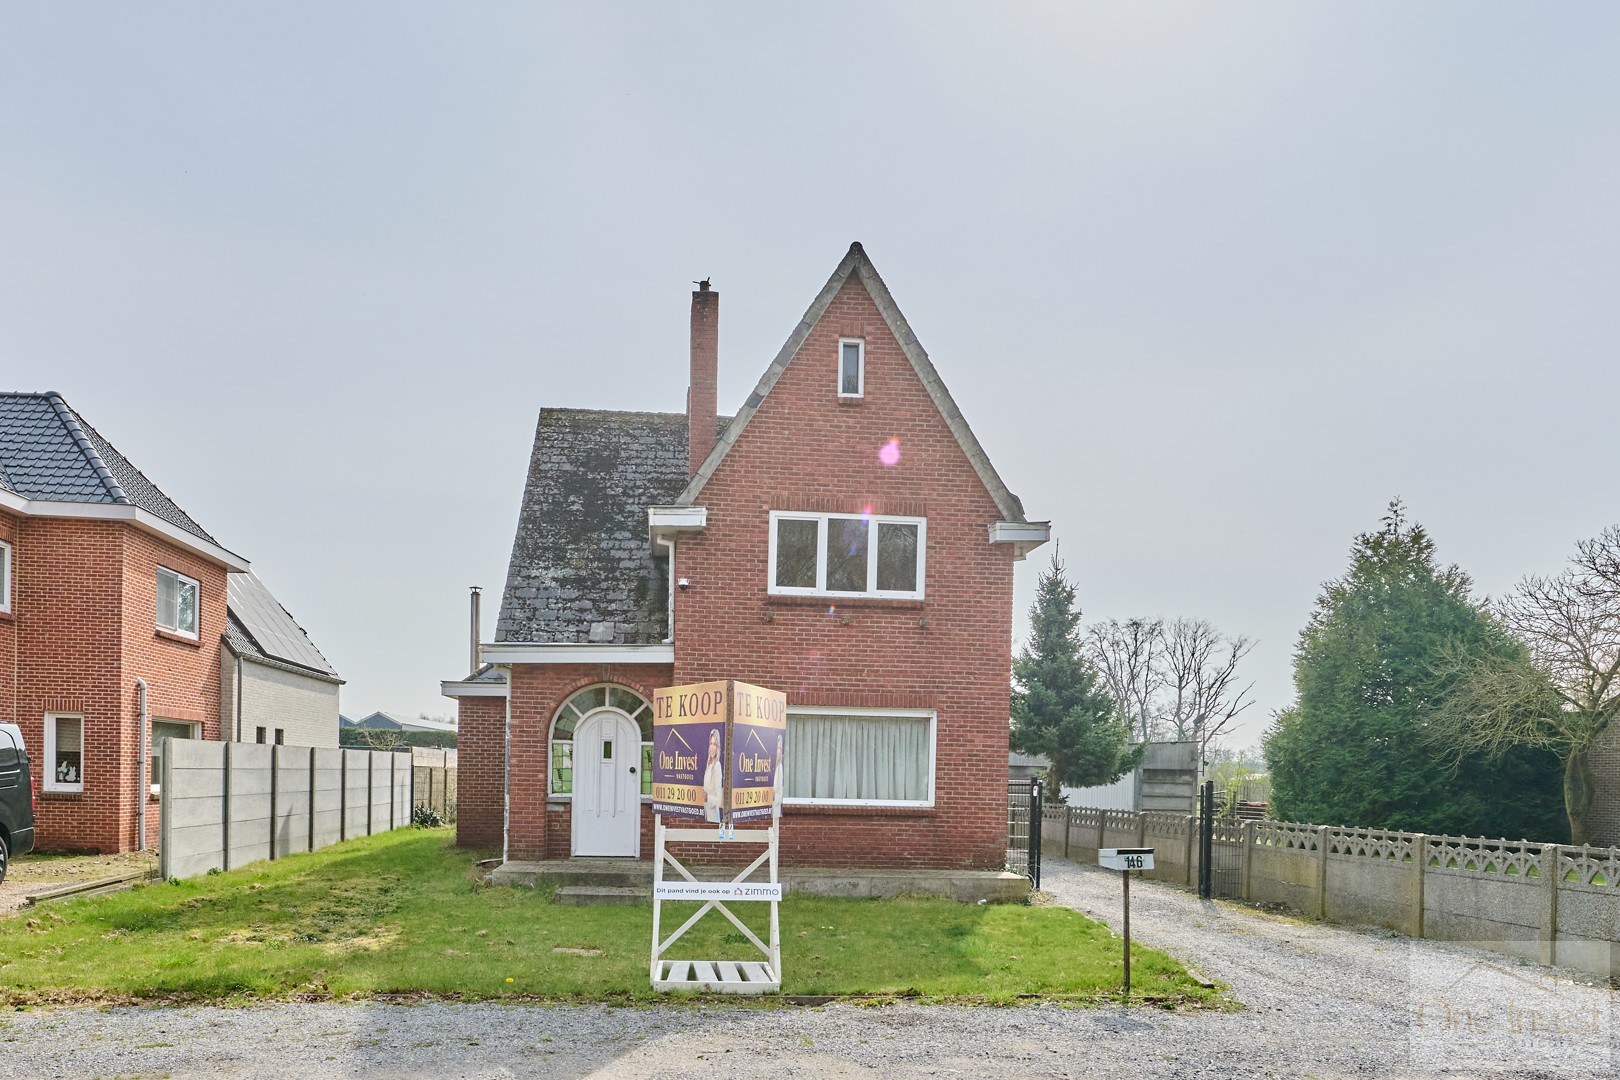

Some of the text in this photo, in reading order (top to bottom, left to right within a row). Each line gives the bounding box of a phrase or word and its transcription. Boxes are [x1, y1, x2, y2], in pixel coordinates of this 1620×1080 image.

[656, 690, 723, 719] TE KOOP
[737, 691, 785, 722] TE KOOP
[659, 750, 698, 771] One Invest
[739, 752, 772, 773] One Invest
[655, 786, 697, 802] 011 29 20 00
[735, 790, 769, 805] 011 29 20 00
[1125, 855, 1143, 869] 146
[744, 887, 779, 896] zimmo
